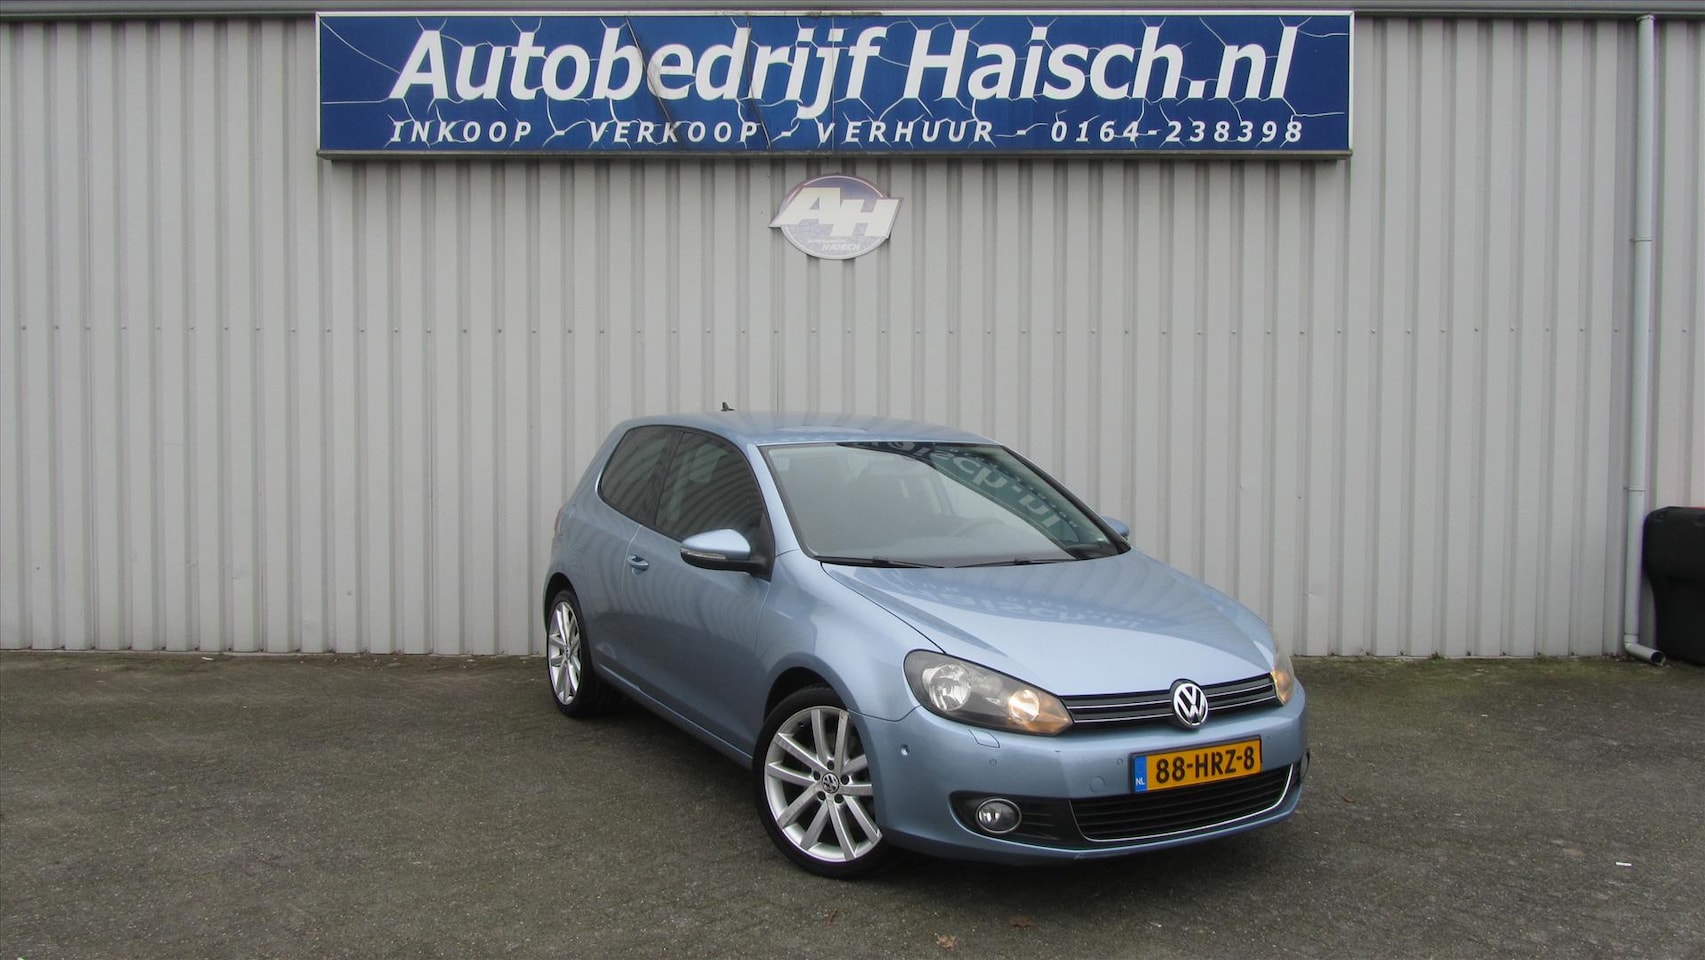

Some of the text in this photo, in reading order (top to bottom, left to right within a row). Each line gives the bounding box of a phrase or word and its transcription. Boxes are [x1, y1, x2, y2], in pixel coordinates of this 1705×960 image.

[389, 26, 1298, 119] Autobedrijf Haisch.nl
[391, 121, 532, 142] INKOOP
[590, 121, 759, 142] VERKOOP
[817, 121, 993, 142] VERHUUR
[1051, 120, 1302, 142] 0164-238398
[771, 187, 899, 237] AH
[1135, 746, 1255, 786] NL 88-HRZ-8
